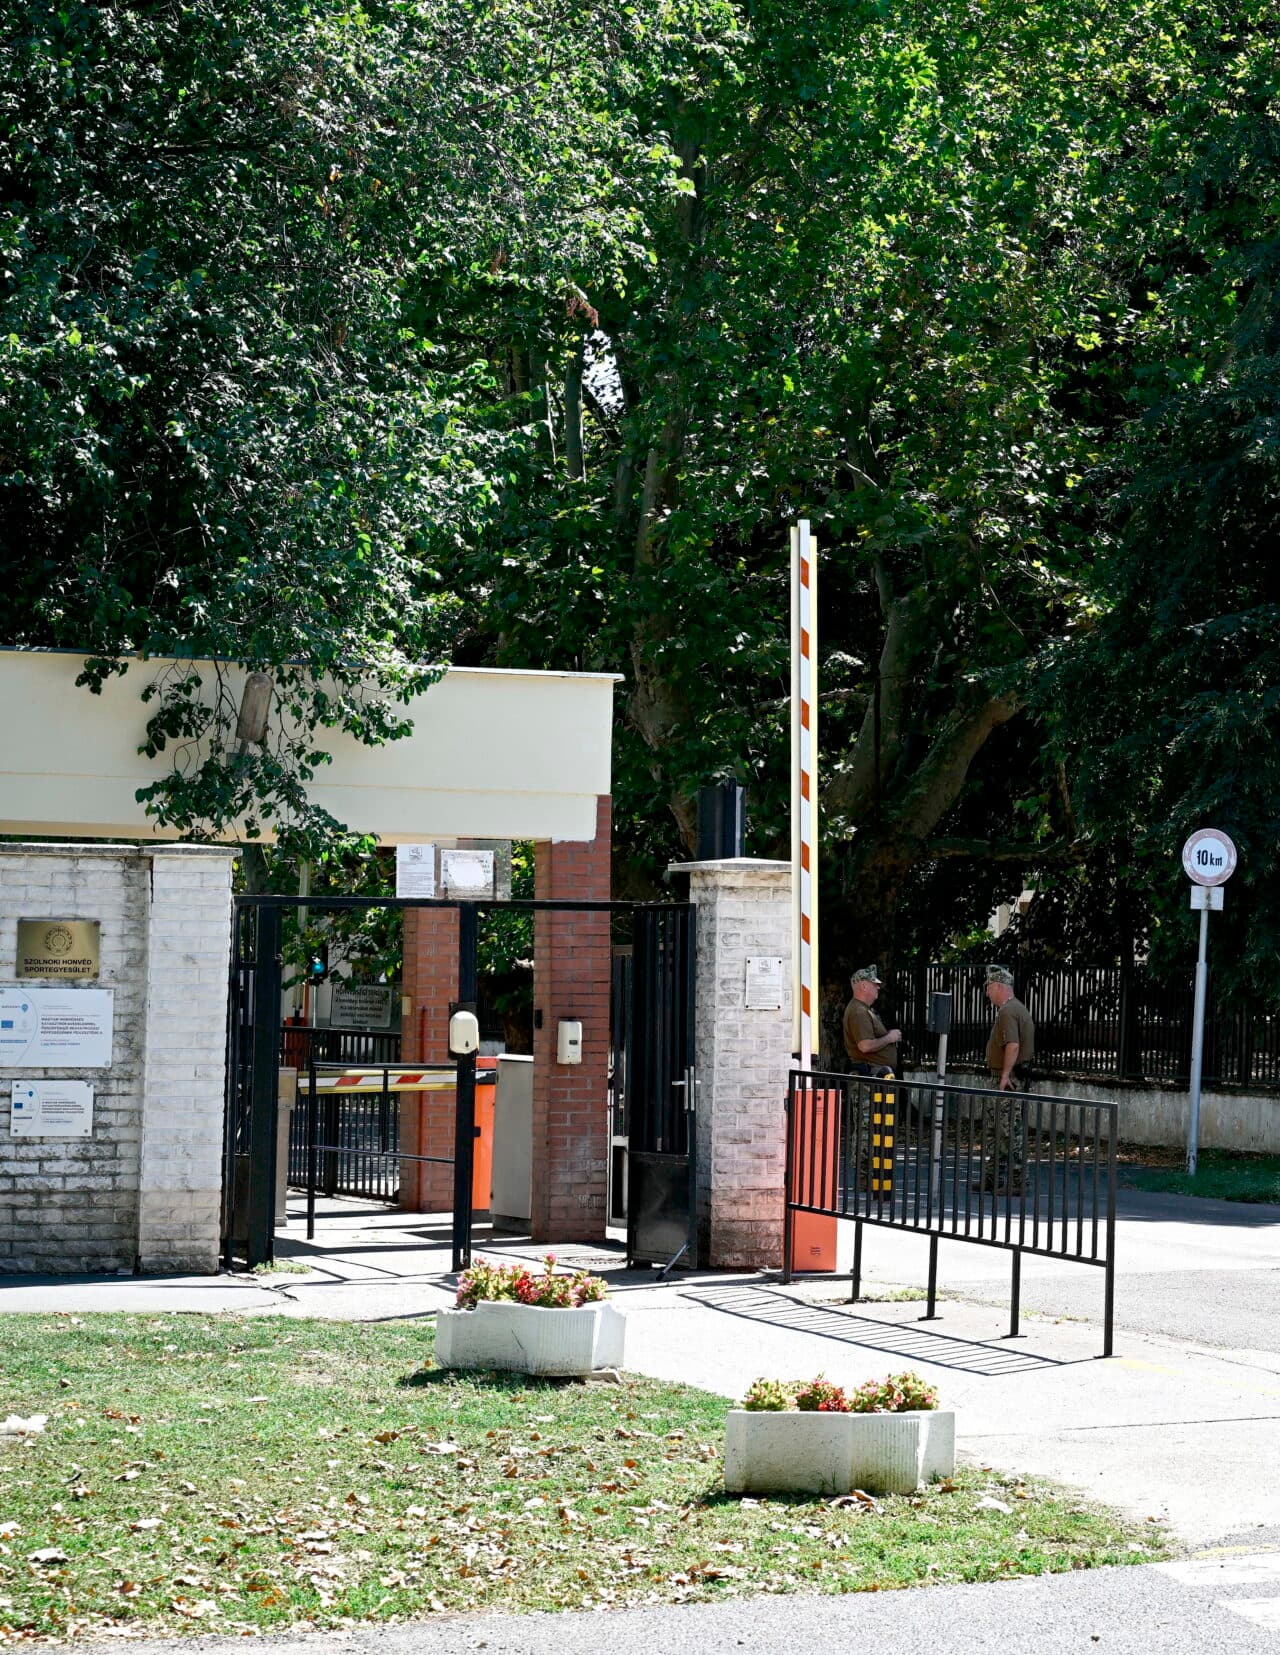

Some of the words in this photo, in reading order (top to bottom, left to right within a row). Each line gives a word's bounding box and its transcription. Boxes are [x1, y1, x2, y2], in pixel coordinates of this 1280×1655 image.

[1197, 850, 1208, 866] 10
[1210, 853, 1222, 866] km
[62, 957, 92, 965] HONVÉD
